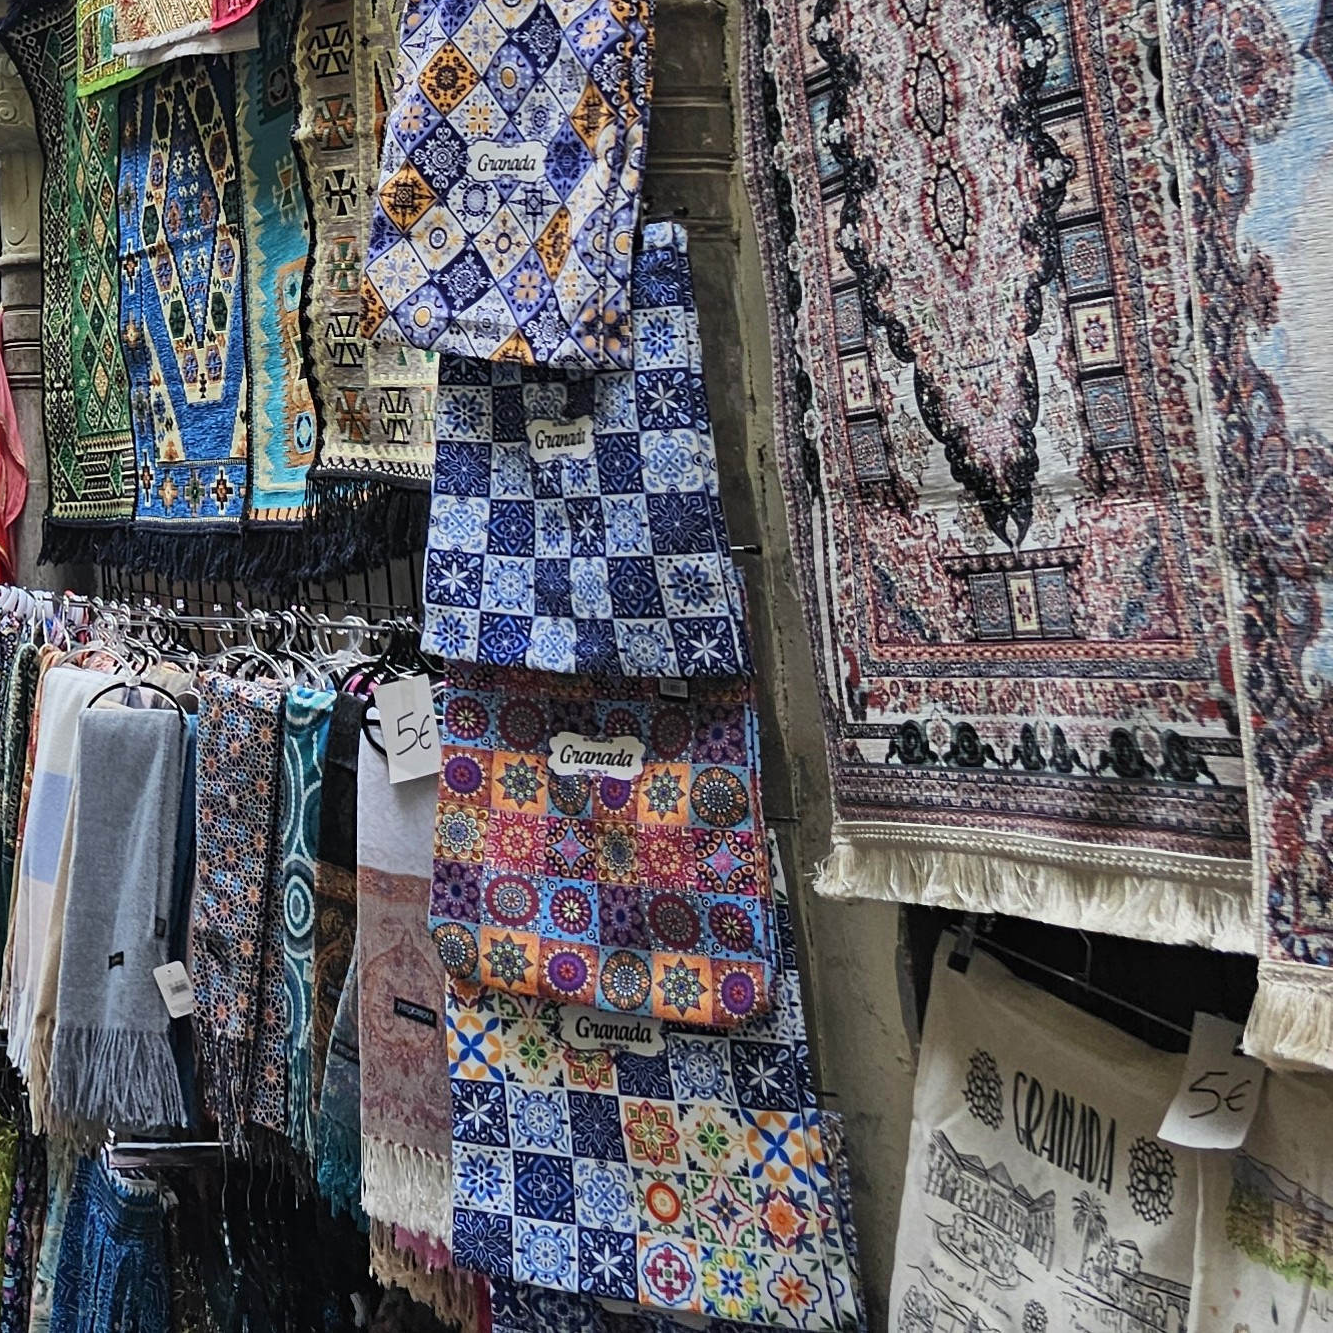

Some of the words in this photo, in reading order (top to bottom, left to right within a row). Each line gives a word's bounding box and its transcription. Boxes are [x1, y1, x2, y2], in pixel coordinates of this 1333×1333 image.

[477, 152, 536, 173] Granada
[534, 427, 587, 449] Granada
[396, 711, 432, 756] 5€
[560, 744, 634, 769] Granada
[575, 1016, 653, 1045] Granada
[1188, 1071, 1252, 1119] 5€
[1013, 1071, 1116, 1195] GRANADA
